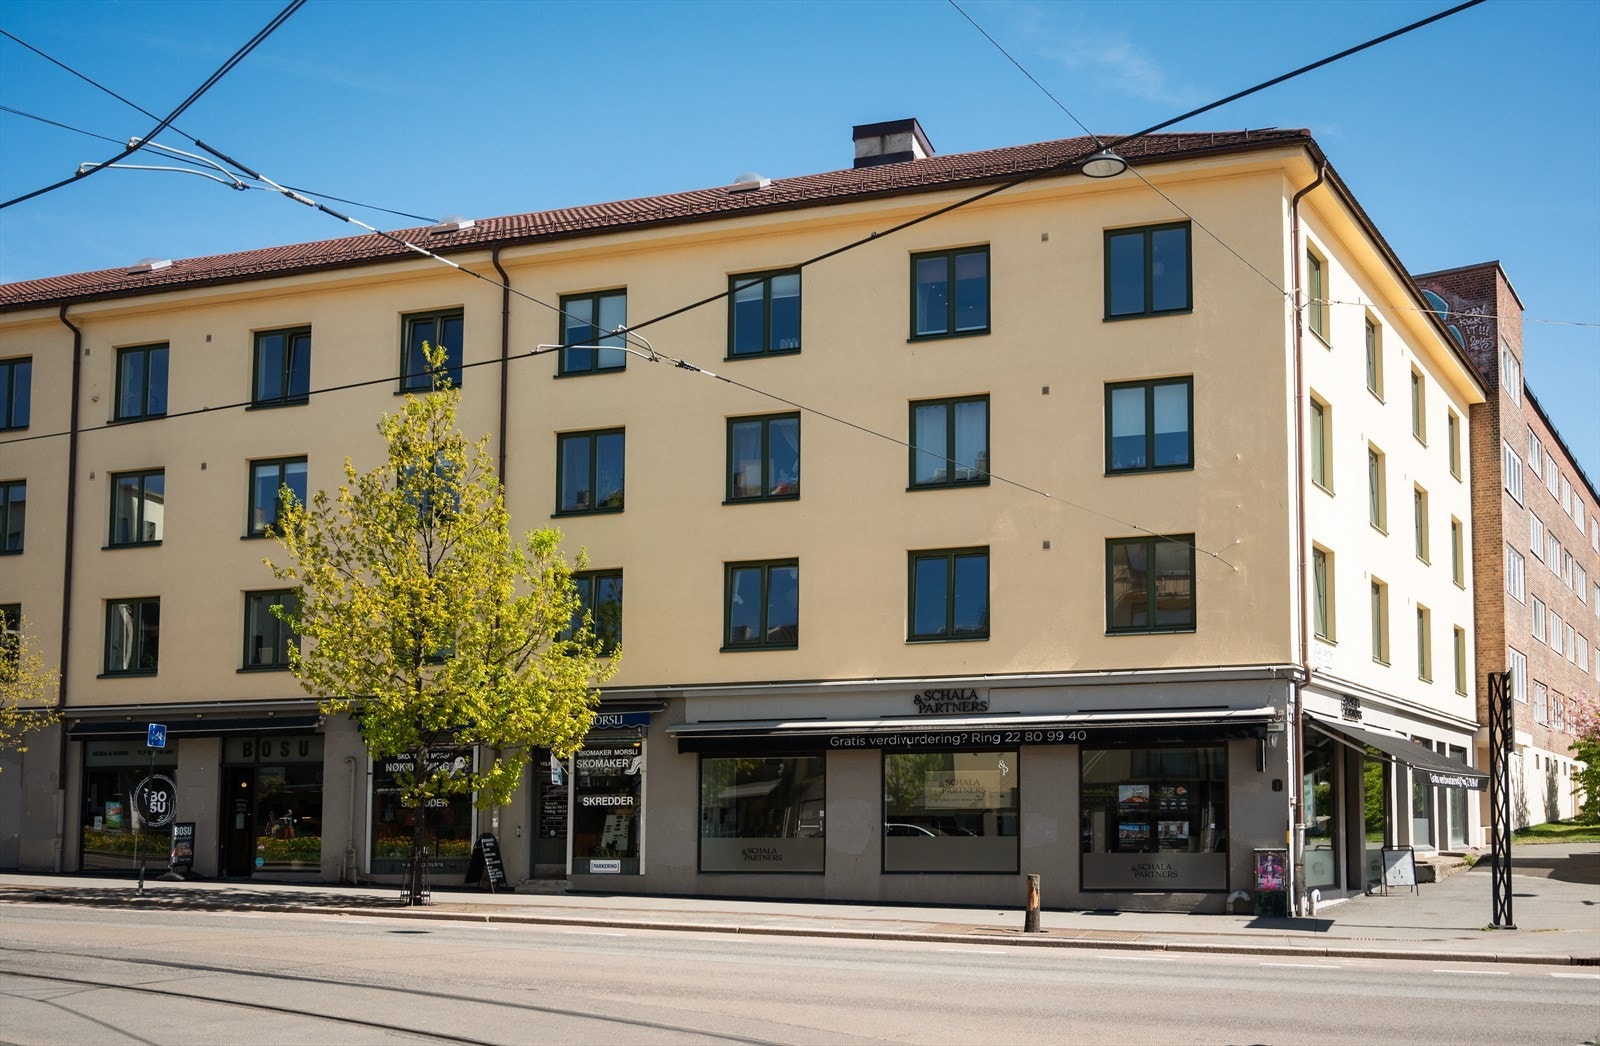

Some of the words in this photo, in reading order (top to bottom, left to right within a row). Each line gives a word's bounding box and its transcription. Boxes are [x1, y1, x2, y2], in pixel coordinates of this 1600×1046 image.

[923, 688, 979, 701] SCHALA
[918, 701, 988, 713] PARTNERS
[830, 736, 866, 746] Gratis
[869, 733, 968, 746] verdivurdering?
[971, 732, 1000, 744] Ring
[1004, 732, 1020, 742] 22
[1024, 731, 1042, 741] 80
[1047, 730, 1064, 741] 99
[1068, 730, 1087, 741] 40
[243, 741, 309, 758] BOSU
[576, 759, 629, 768] SKOMAKER
[942, 786, 986, 794] PARTNERS
[583, 796, 634, 806] SKREDDER
[174, 826, 192, 836] BOSU
[1134, 870, 1178, 878] PARTNERS
